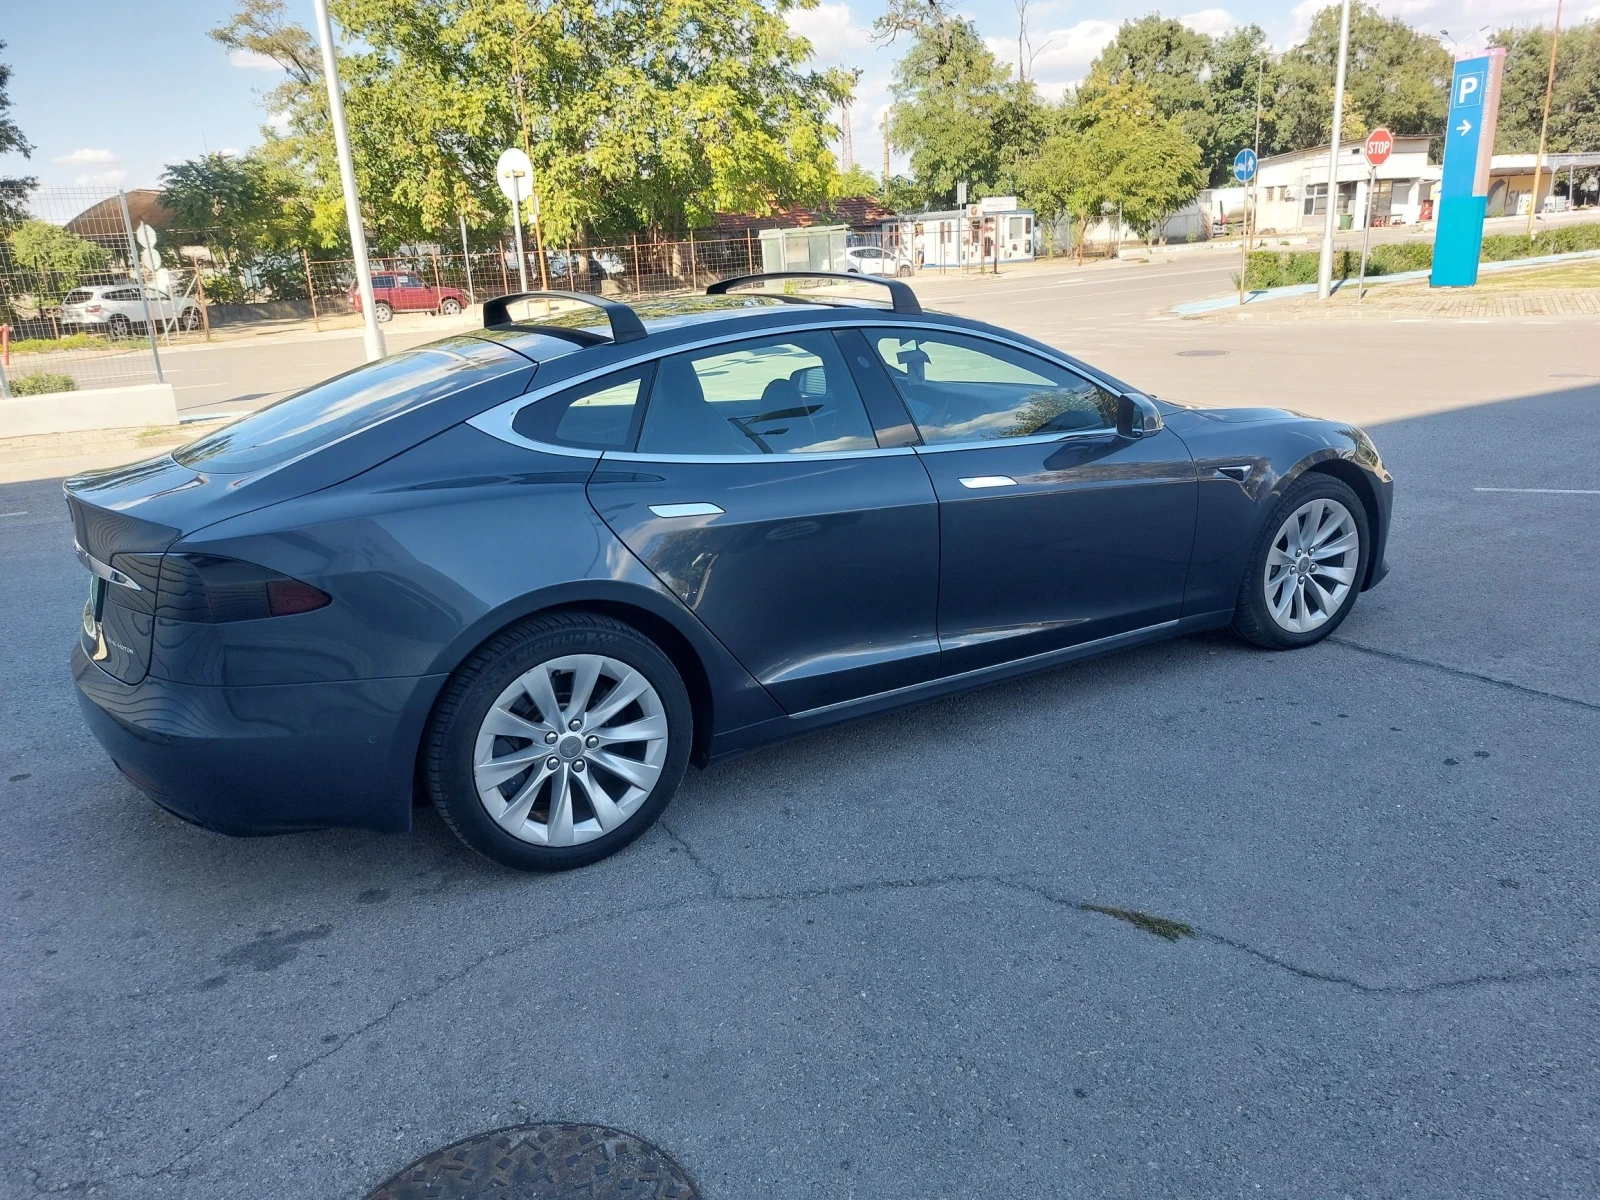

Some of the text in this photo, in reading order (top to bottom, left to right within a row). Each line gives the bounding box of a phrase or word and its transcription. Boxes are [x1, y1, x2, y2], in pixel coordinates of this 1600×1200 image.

[1459, 77, 1478, 104] P
[1368, 141, 1390, 155] STOP
[516, 633, 586, 663] MICHELIN
